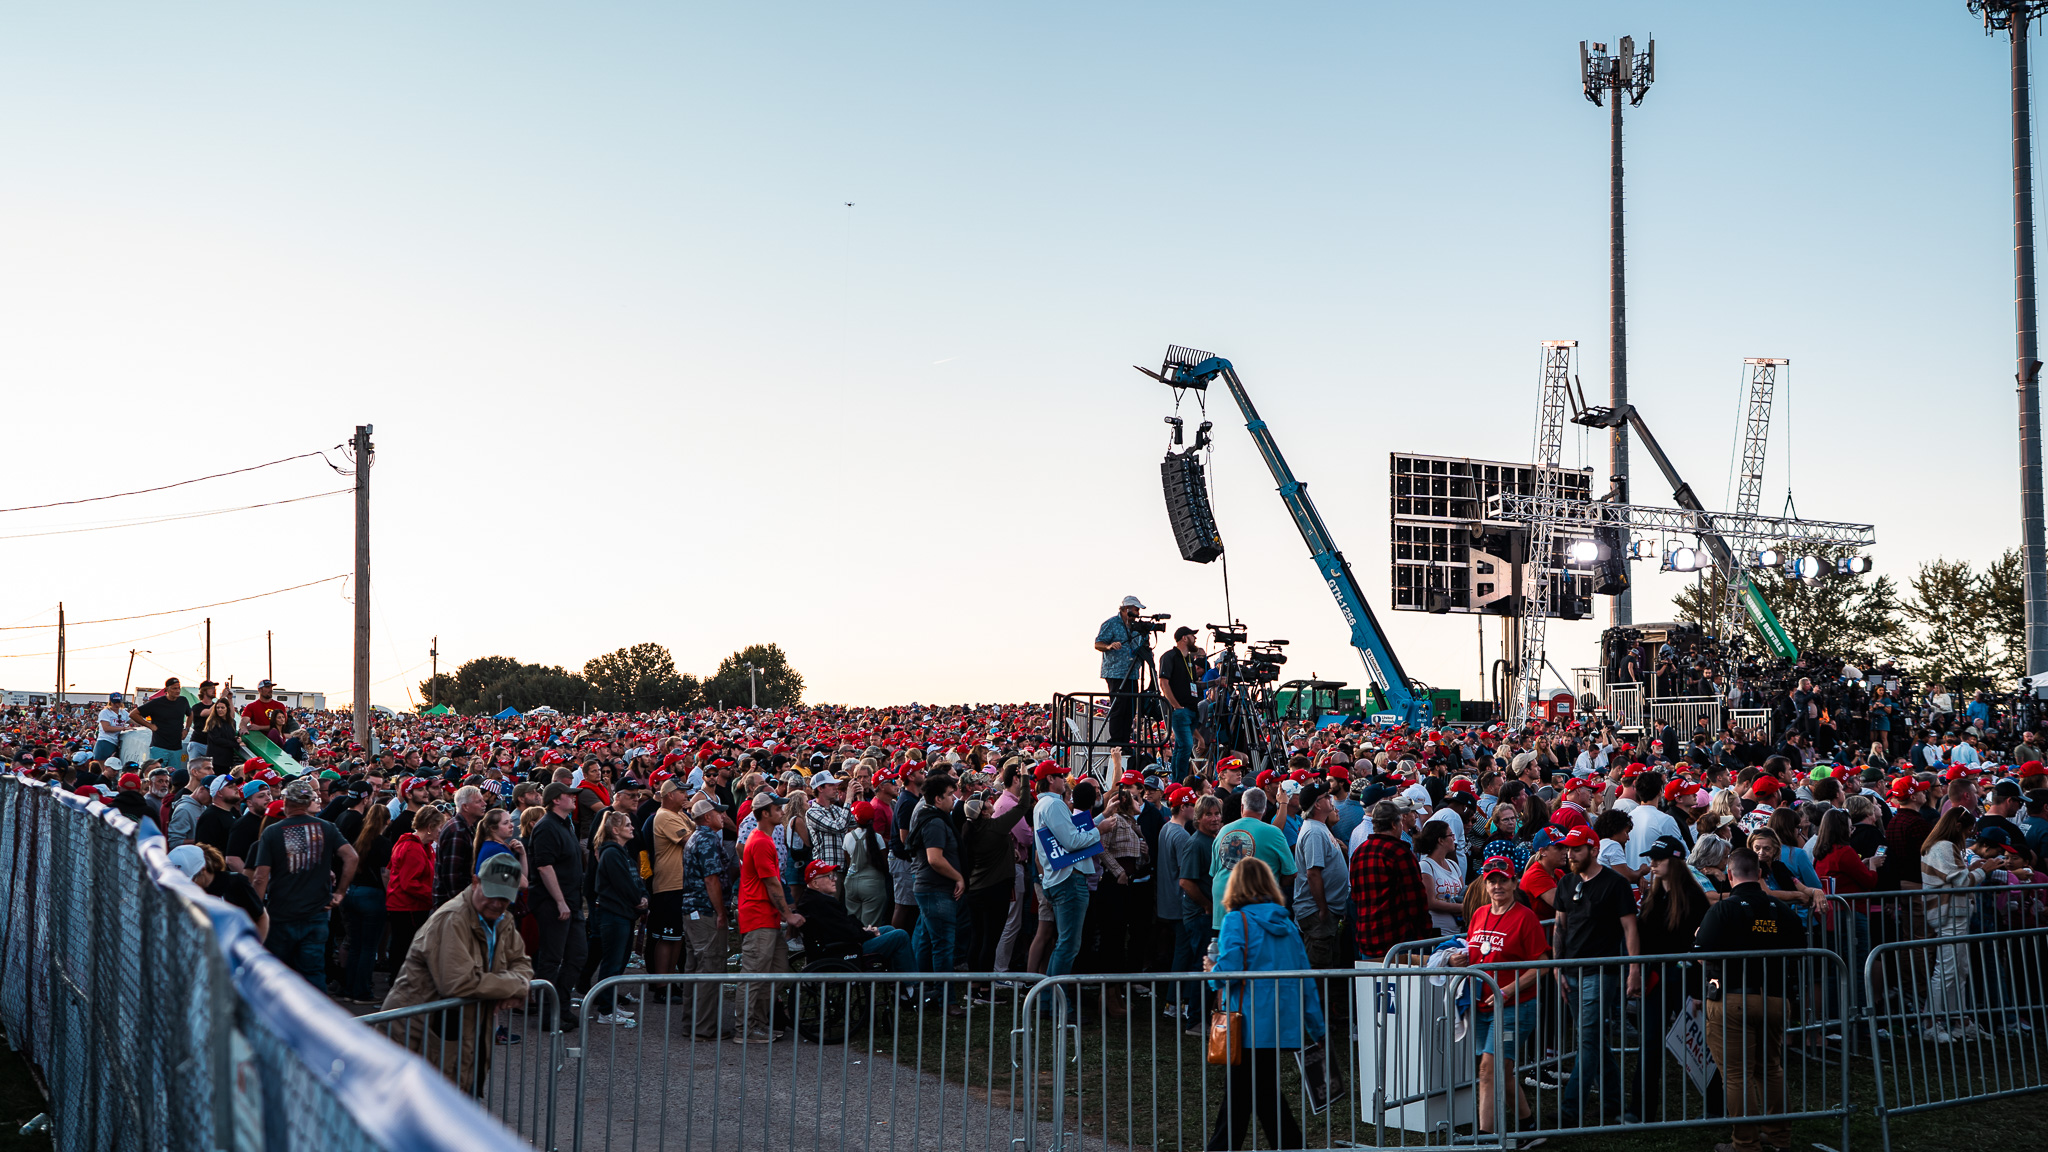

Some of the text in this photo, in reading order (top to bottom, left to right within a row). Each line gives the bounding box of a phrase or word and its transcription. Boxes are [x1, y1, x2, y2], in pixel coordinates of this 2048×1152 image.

[1328, 579, 1357, 626] GTH-1256
[1746, 594, 1785, 653] SUNBELT RENTALS
[1377, 671, 1388, 689] Rentals
[1907, 787, 1915, 795] 45
[1181, 795, 1189, 803] 45
[1755, 919, 1776, 927] STATE
